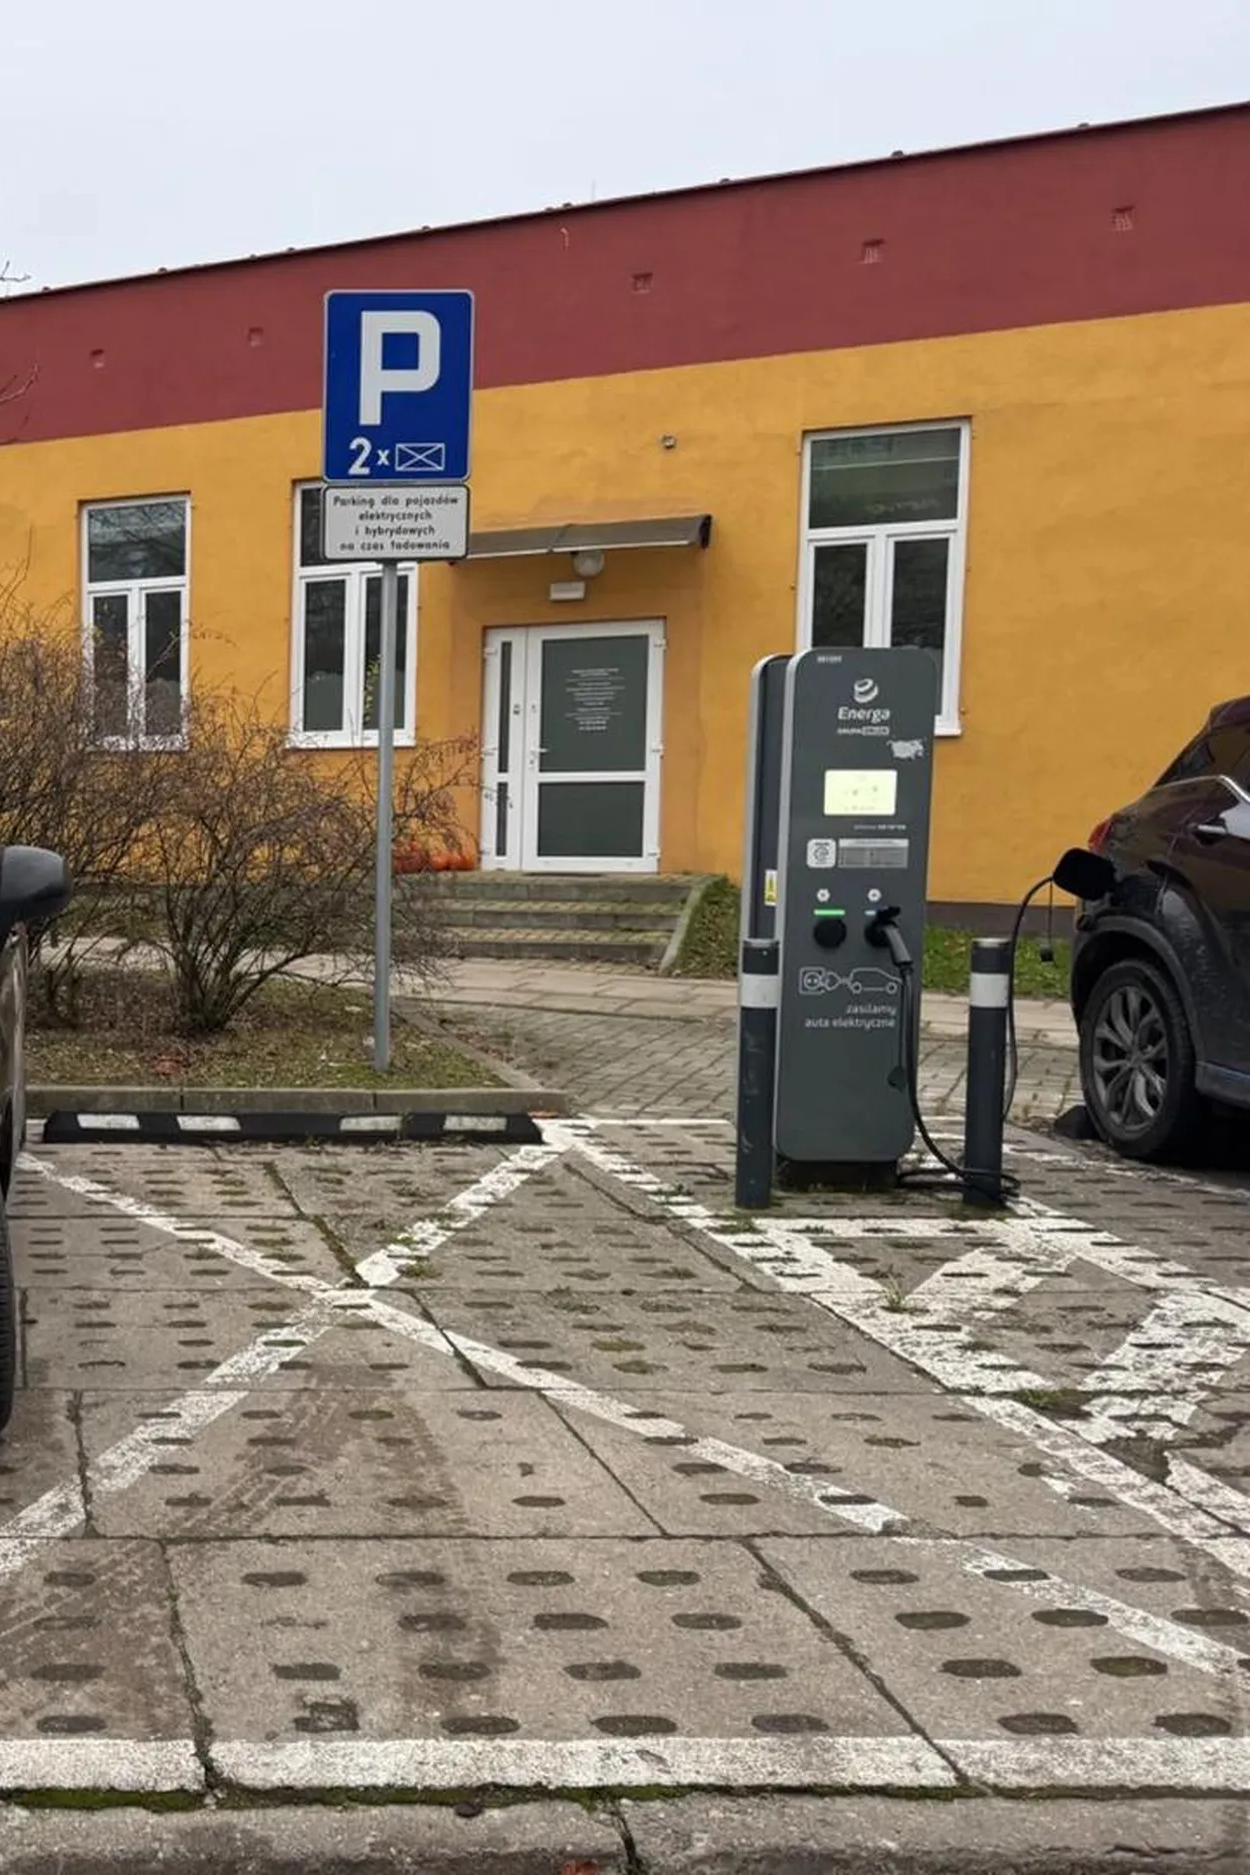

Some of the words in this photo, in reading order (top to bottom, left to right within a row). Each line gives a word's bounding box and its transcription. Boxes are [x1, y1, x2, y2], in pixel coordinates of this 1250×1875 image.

[359, 311, 441, 425] P
[348, 437, 372, 475] 2
[333, 495, 375, 508] Parking
[381, 496, 399, 505] dla
[406, 495, 458, 508] pojazdów
[359, 510, 432, 523] elektrycznych
[365, 525, 435, 538] hybrydowych
[340, 542, 355, 551] na
[360, 541, 384, 551] czas
[837, 706, 891, 724] Energa
[846, 1003, 897, 1016] zasilamy
[805, 1018, 829, 1029] auta
[832, 1016, 896, 1031] elektryczne
